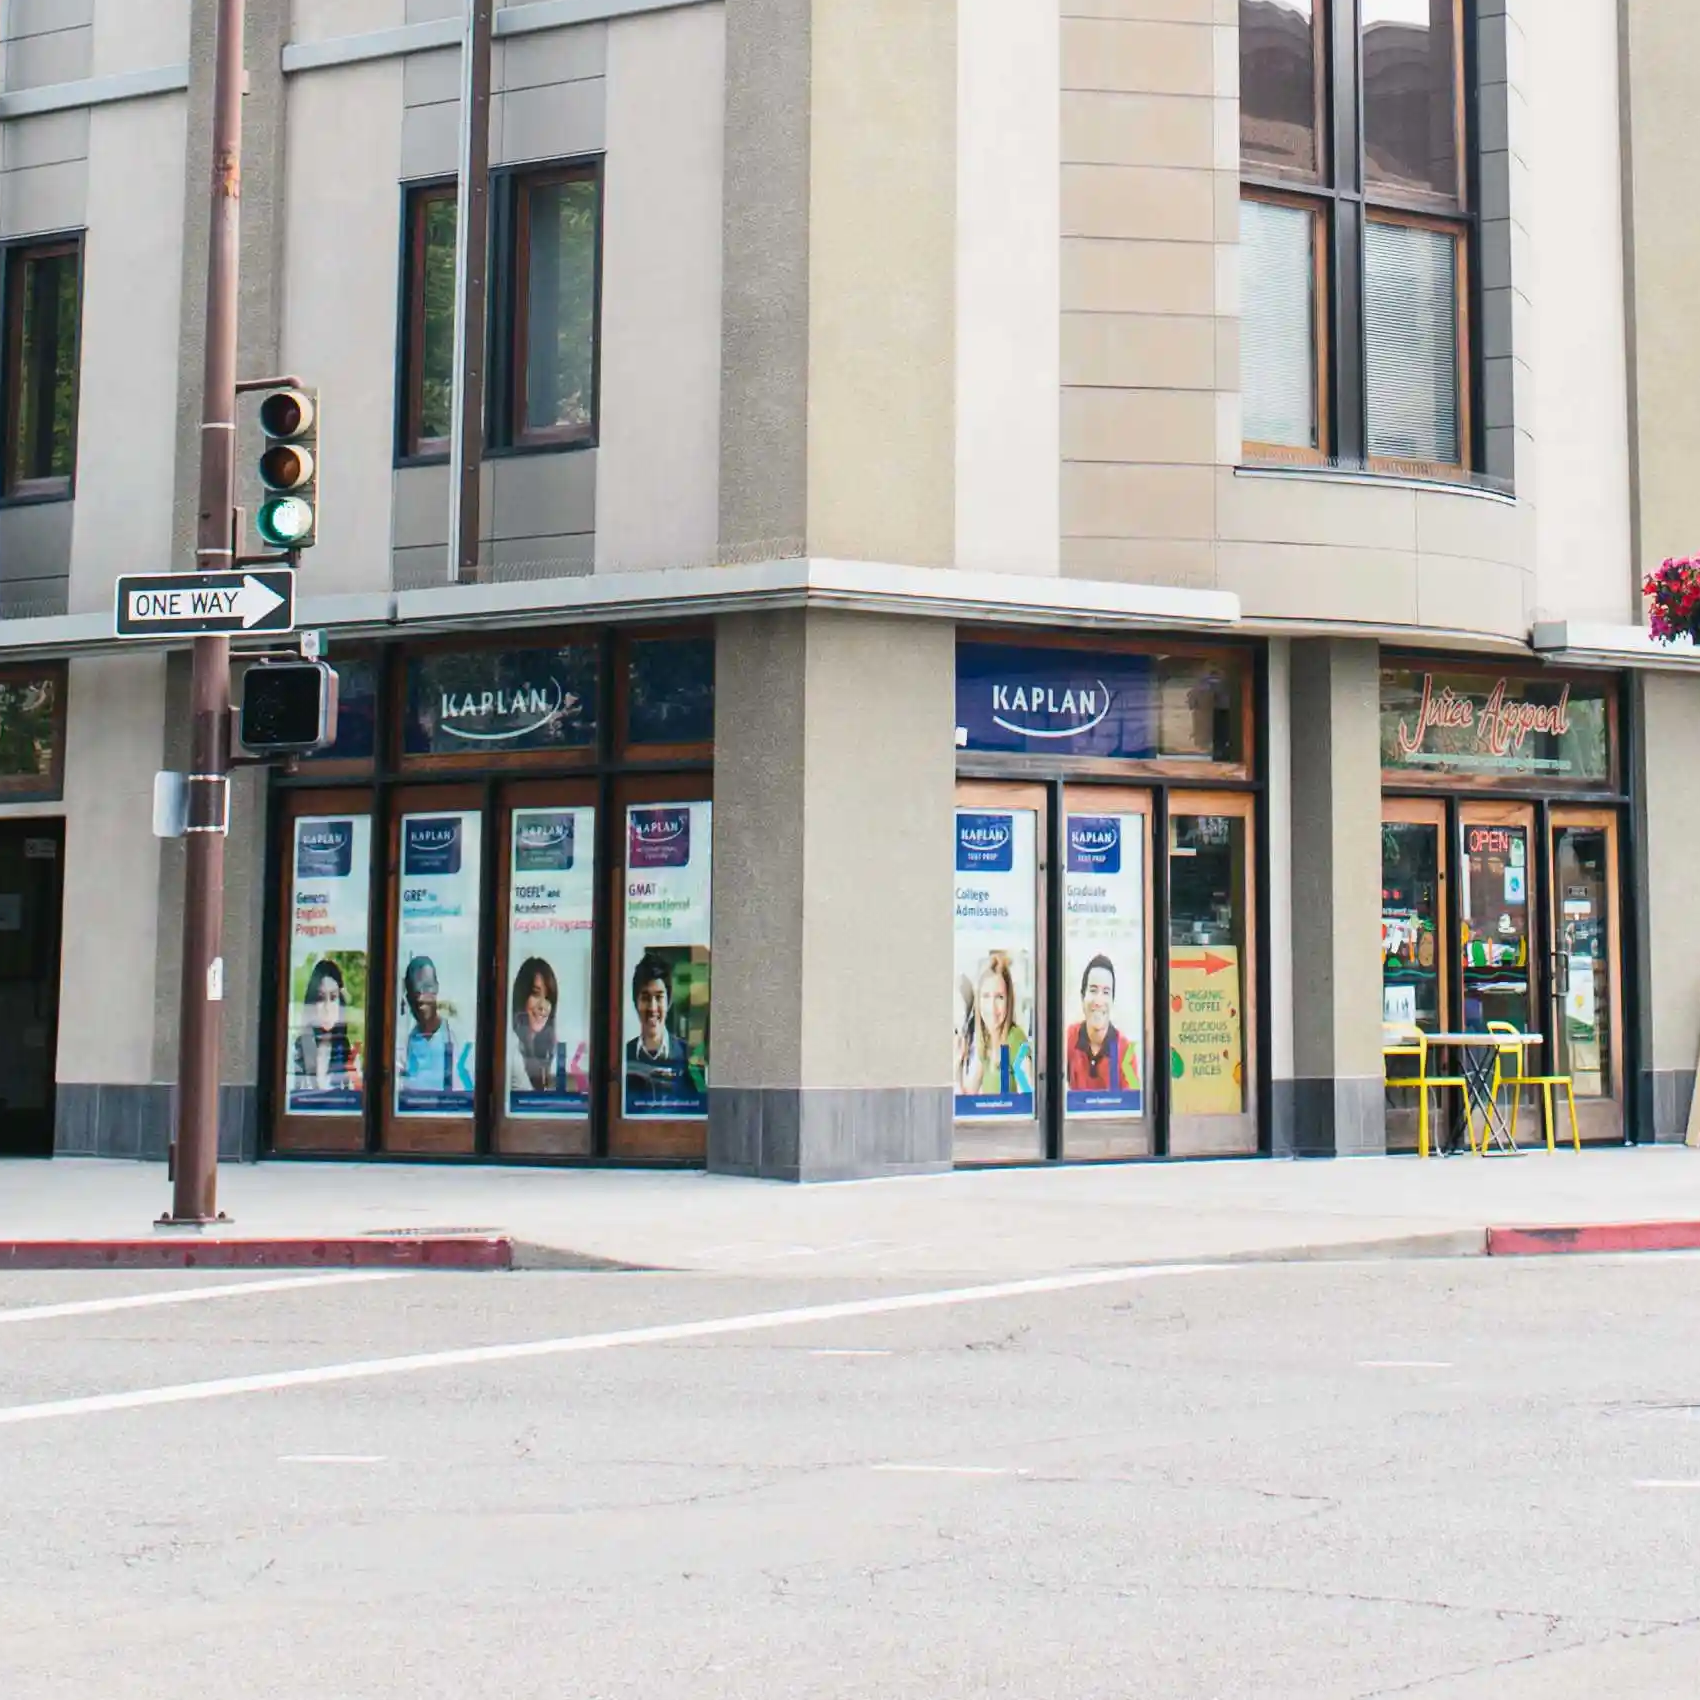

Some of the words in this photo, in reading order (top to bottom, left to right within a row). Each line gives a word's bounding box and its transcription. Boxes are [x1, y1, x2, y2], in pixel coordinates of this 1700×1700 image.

[136, 593, 181, 616] ONE
[191, 591, 238, 615] WAY
[442, 688, 547, 718] KAPLAN
[993, 685, 1096, 715] KAPLAN
[1400, 673, 1473, 752] Juice
[1477, 677, 1571, 755] Appeal
[521, 825, 564, 837] KAPLAN
[636, 821, 678, 834] KAPLAN
[303, 833, 343, 845] KAPLAN
[411, 830, 451, 842] KAPLAN
[961, 828, 1004, 841] KAPLAN
[1072, 830, 1113, 843] KAPLAN
[1470, 830, 1509, 852] OPEN
[956, 888, 990, 903] College
[1067, 884, 1107, 897] Graduate
[296, 891, 330, 904] General
[628, 897, 690, 911] International
[515, 902, 557, 914] Academic
[956, 905, 1009, 917] Admissions
[1067, 900, 1117, 914] Admissions
[296, 907, 328, 922] English
[549, 918, 595, 933] Programs
[628, 916, 672, 929] Students
[295, 924, 337, 937] Programs
[1184, 989, 1225, 1000] ORGANIC
[1188, 1001, 1221, 1012] COFFEE
[1181, 1021, 1228, 1032] DELICIOUS
[1178, 1033, 1232, 1044] SMOOTHIES
[1192, 1052, 1220, 1064] FRESH
[1192, 1065, 1222, 1077] JUICES
